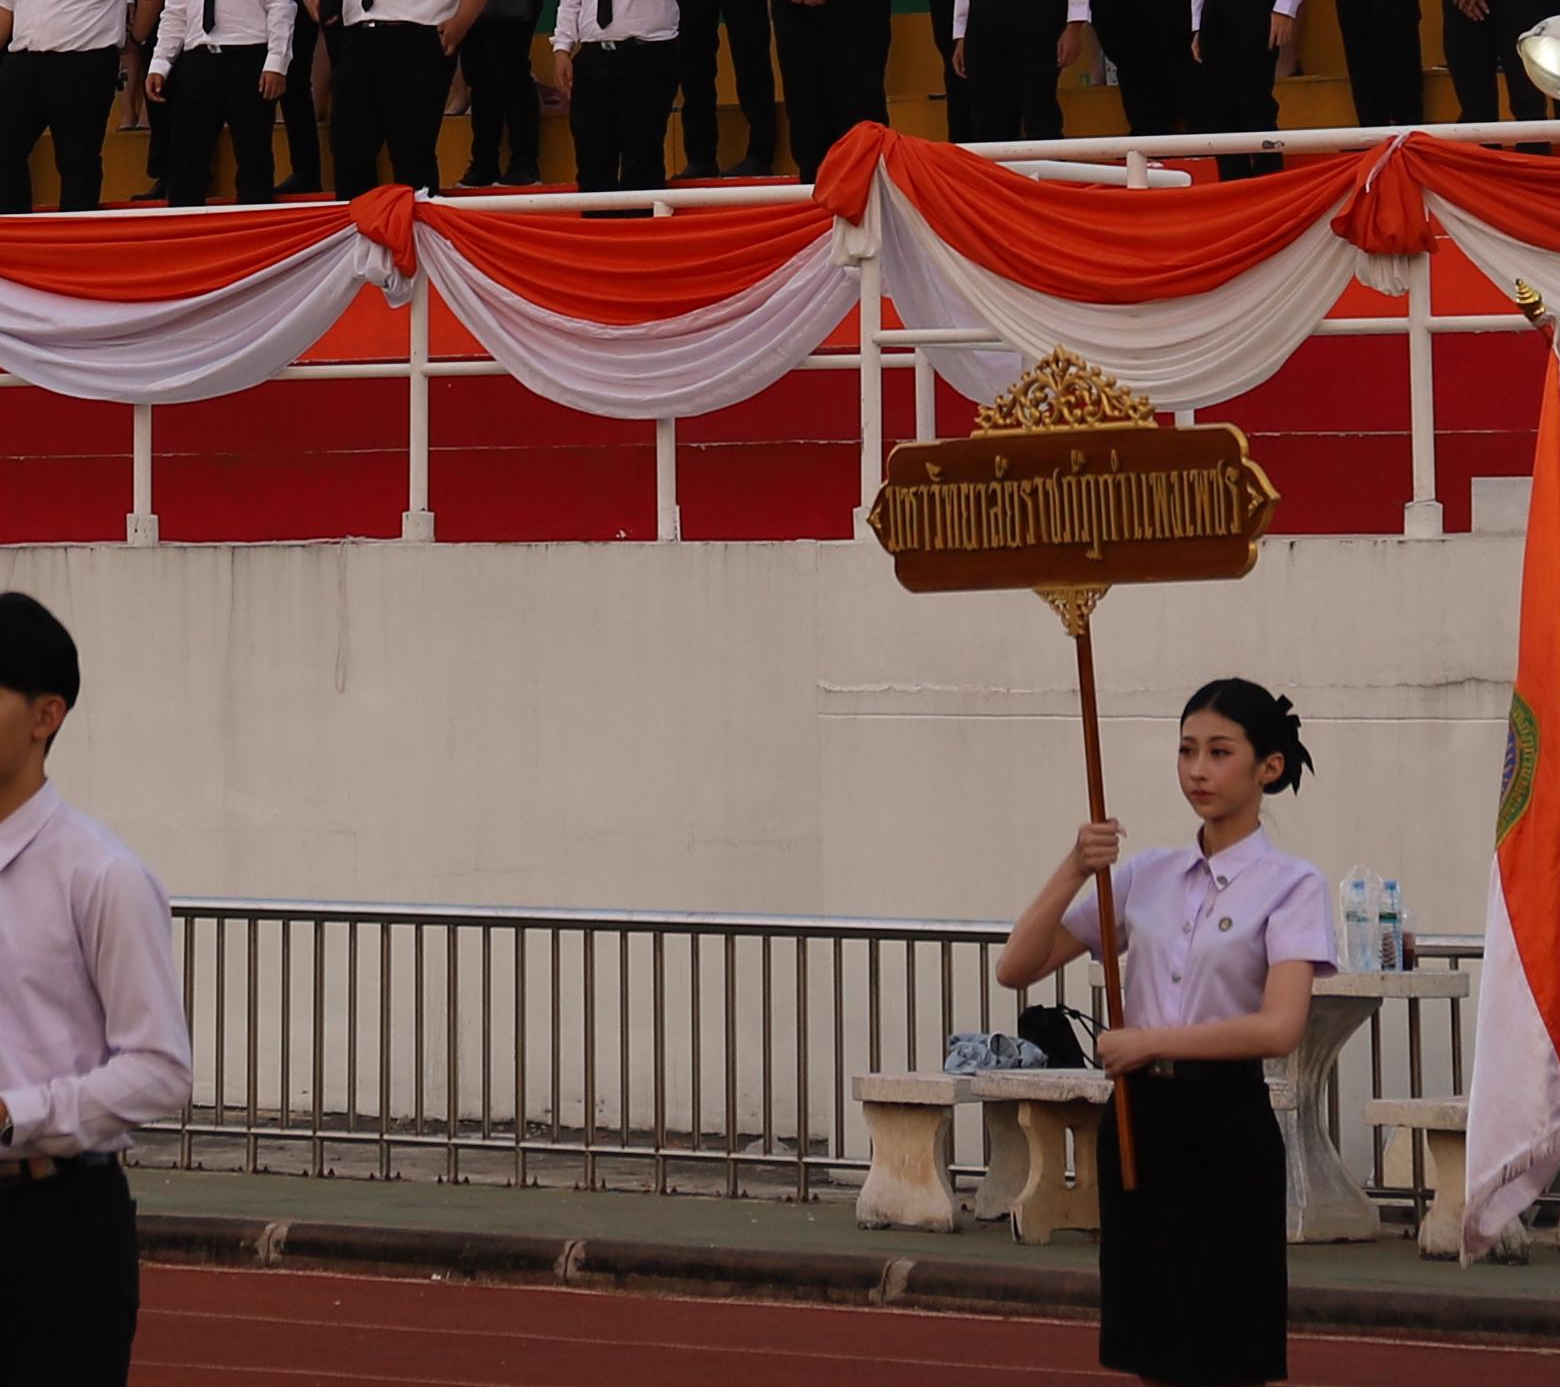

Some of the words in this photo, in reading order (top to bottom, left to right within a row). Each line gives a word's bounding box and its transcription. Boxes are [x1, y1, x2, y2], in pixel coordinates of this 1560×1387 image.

[886, 449, 1242, 560] มหาวิทยาลัยราชภัฏกำแพงเพชร
